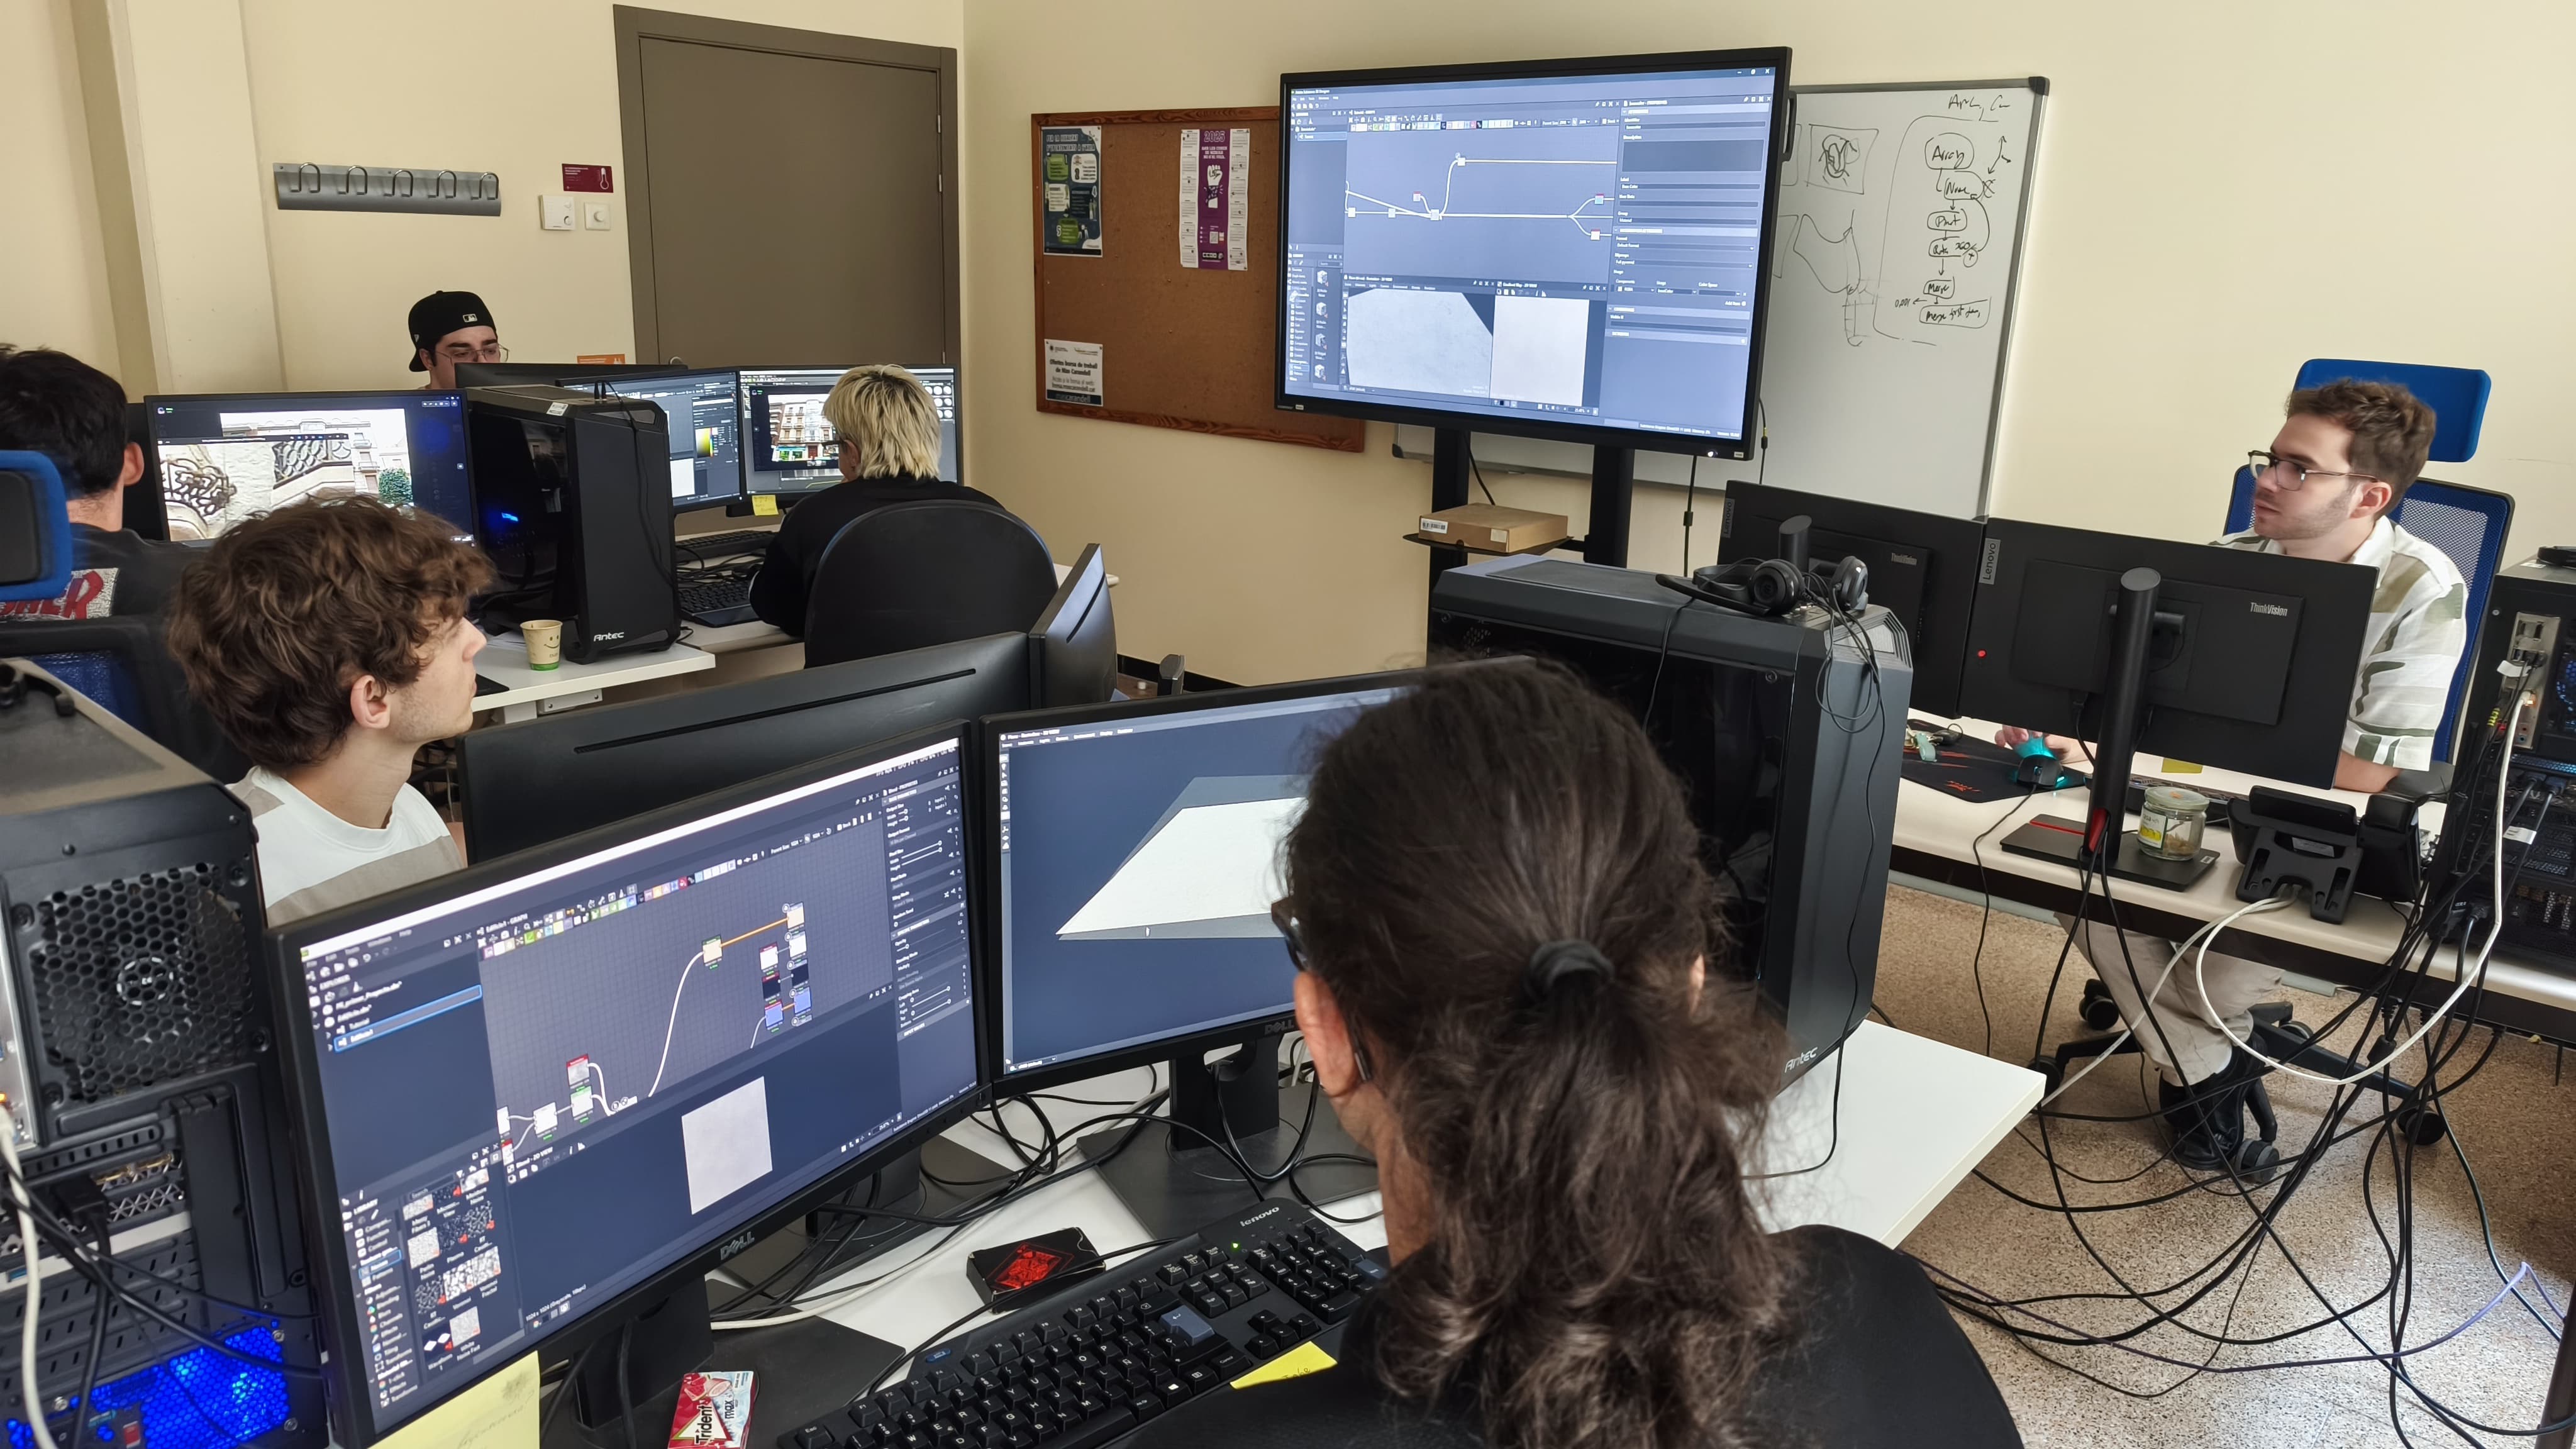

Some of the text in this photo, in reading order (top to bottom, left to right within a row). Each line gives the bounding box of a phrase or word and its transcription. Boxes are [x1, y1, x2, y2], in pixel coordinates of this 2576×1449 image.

[1204, 131, 1225, 142] 2025
[1724, 501, 1733, 535] Lenovo
[1891, 552, 1918, 566] ThinkVision
[1984, 542, 1996, 580] Lenovo
[2250, 602, 2288, 616] ThinkVision
[594, 632, 625, 642] Antec
[1265, 1019, 1295, 1035] DELL
[1784, 1046, 1818, 1074] Antec
[353, 1198, 377, 1214] LIBRARY
[1240, 1207, 1280, 1226] lenovo
[720, 1231, 755, 1260] DELL
[540, 1304, 550, 1313] 1024
[724, 1400, 735, 1419] max
[696, 1404, 712, 1444] Trident
